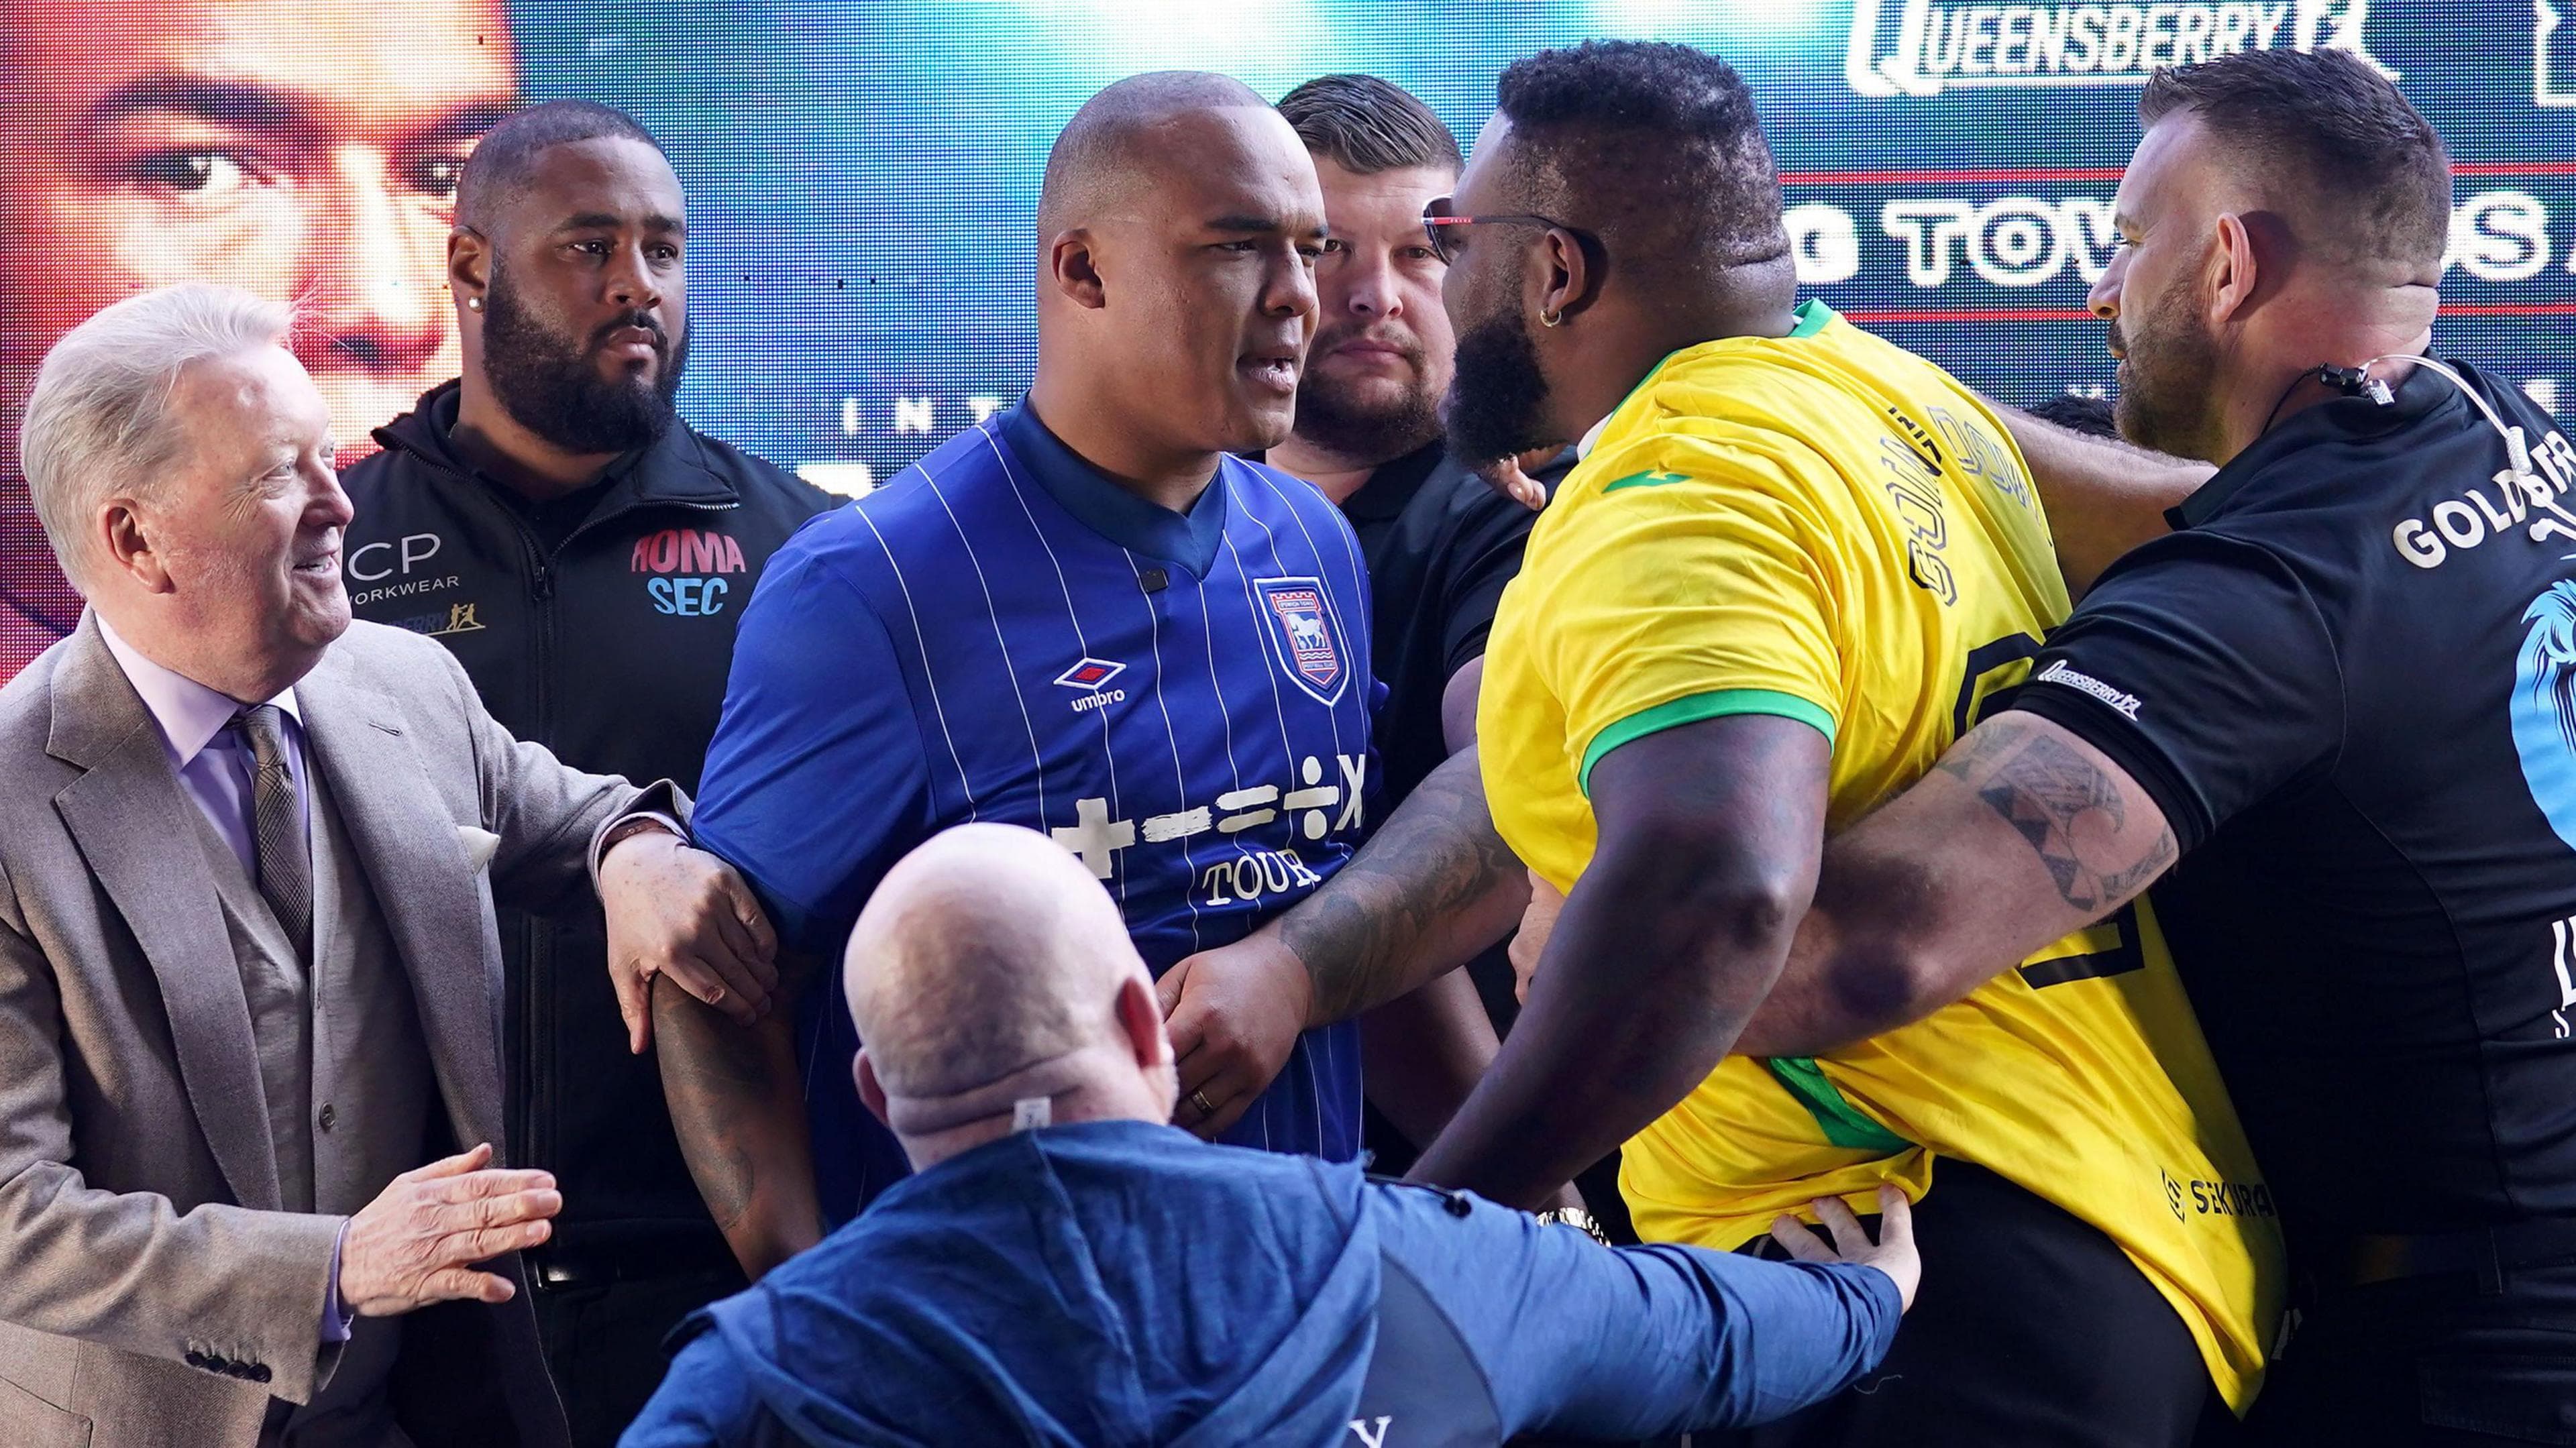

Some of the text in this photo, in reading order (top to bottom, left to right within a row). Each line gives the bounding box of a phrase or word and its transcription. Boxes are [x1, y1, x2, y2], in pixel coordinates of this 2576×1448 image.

[1846, 0, 2293, 97] QUEENSBERRY
[348, 575, 460, 605] ORKWEAR
[647, 577, 729, 616] SEC
[1071, 687, 1126, 712] umbro
[1202, 848, 1322, 905] TOUR
